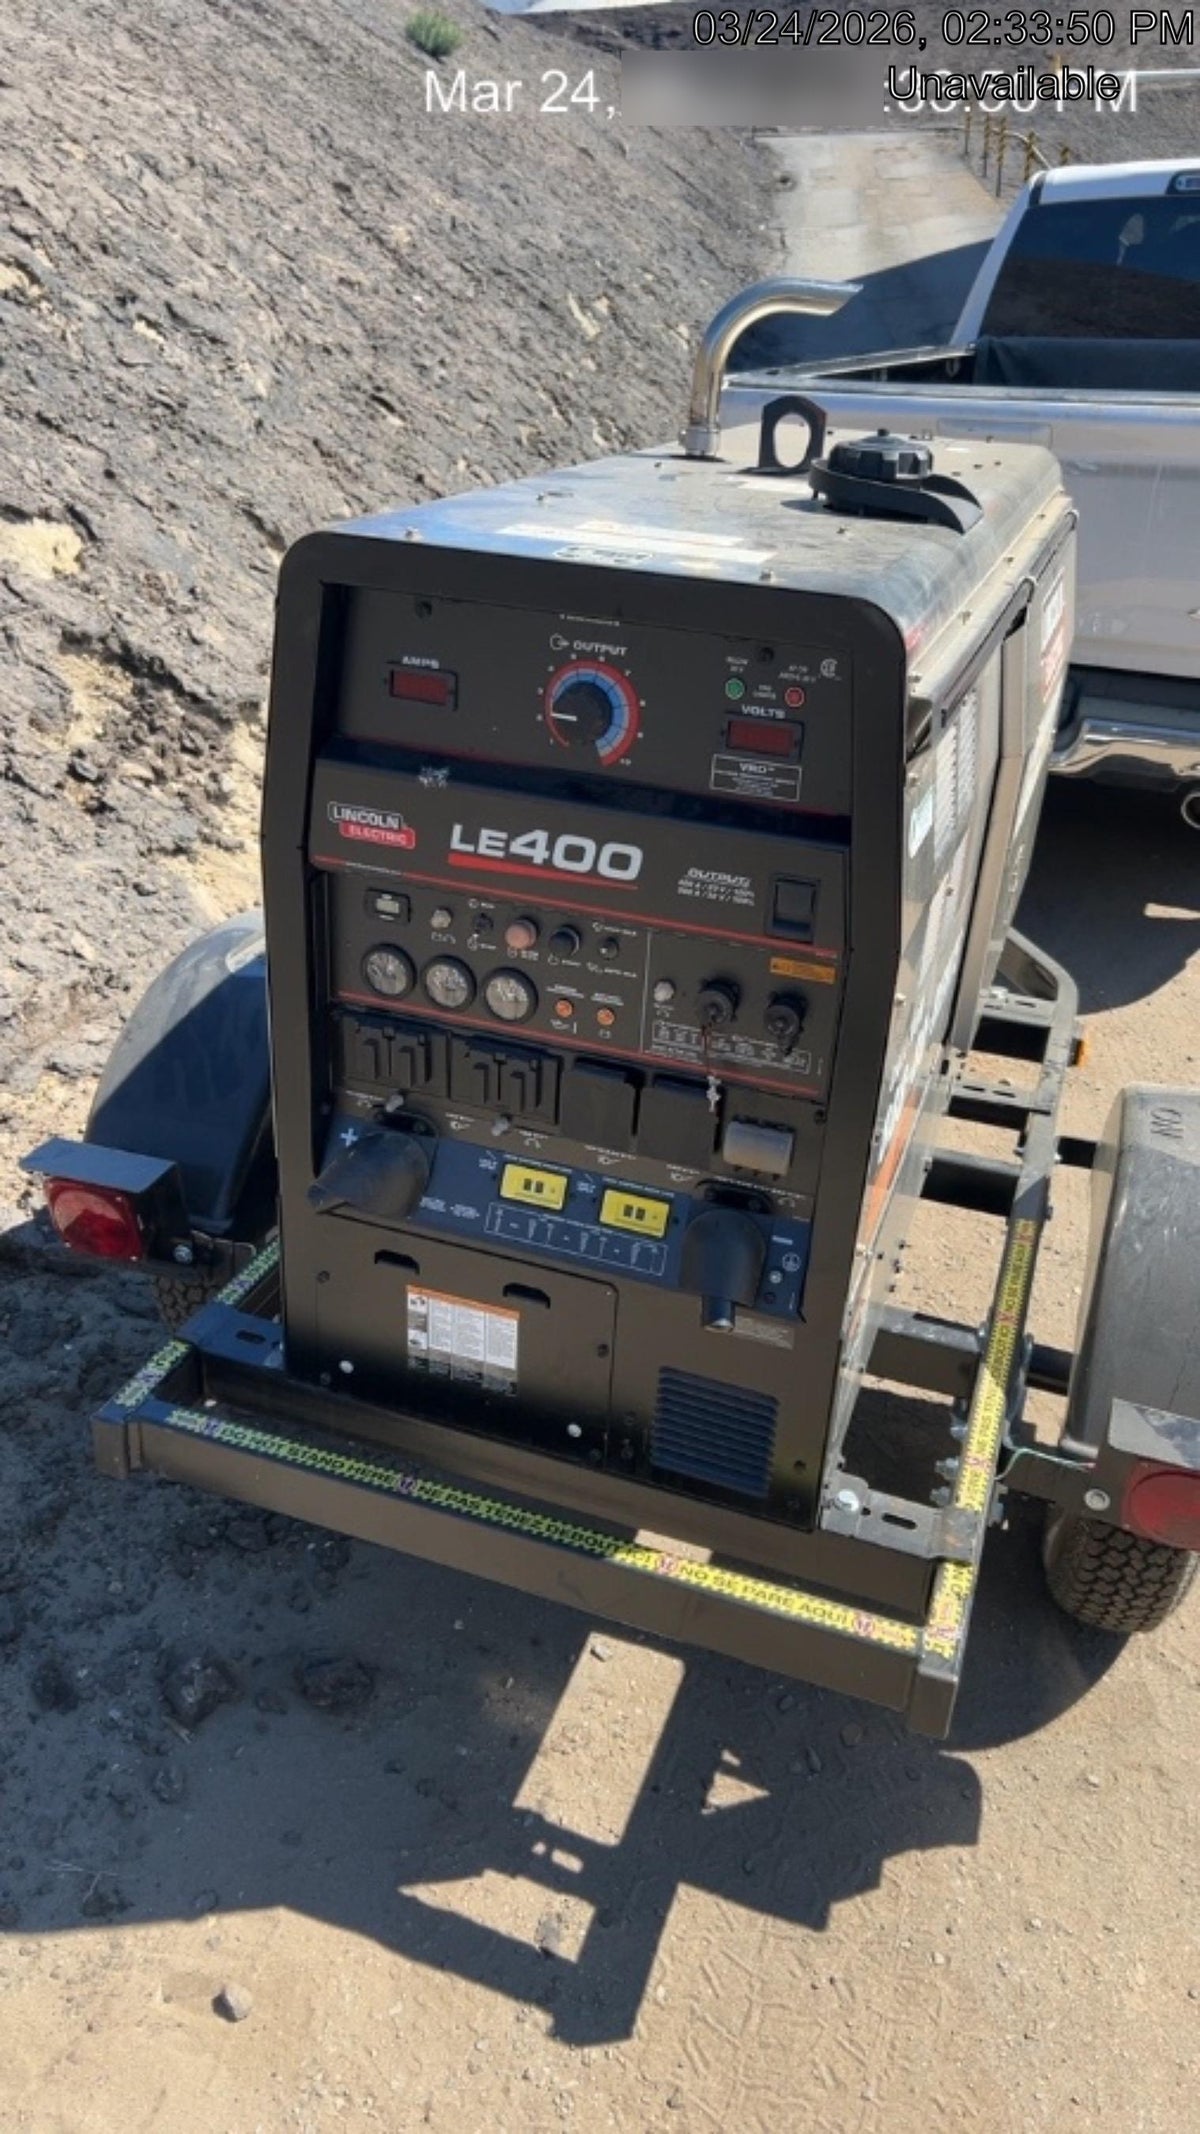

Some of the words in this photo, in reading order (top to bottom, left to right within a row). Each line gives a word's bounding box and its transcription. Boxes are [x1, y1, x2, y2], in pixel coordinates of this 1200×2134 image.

[573, 640, 629, 655] OUTPUT
[741, 705, 786, 718] VOLTS
[334, 805, 399, 830] LINCOLN
[349, 824, 406, 845] ELECTRIC
[449, 823, 643, 881] LE400
[287, 1446, 346, 1468] STAND
[347, 1463, 394, 1482] HERE
[417, 1484, 443, 1497] NE
[445, 1493, 481, 1508] PAS
[484, 1504, 543, 1527] TENEZ
[544, 1522, 622, 1551] DEBOUT
[679, 1565, 710, 1582] NO
[712, 1574, 739, 1591] SE
[741, 1584, 795, 1608] PARE
[797, 1601, 850, 1626] AQUI
